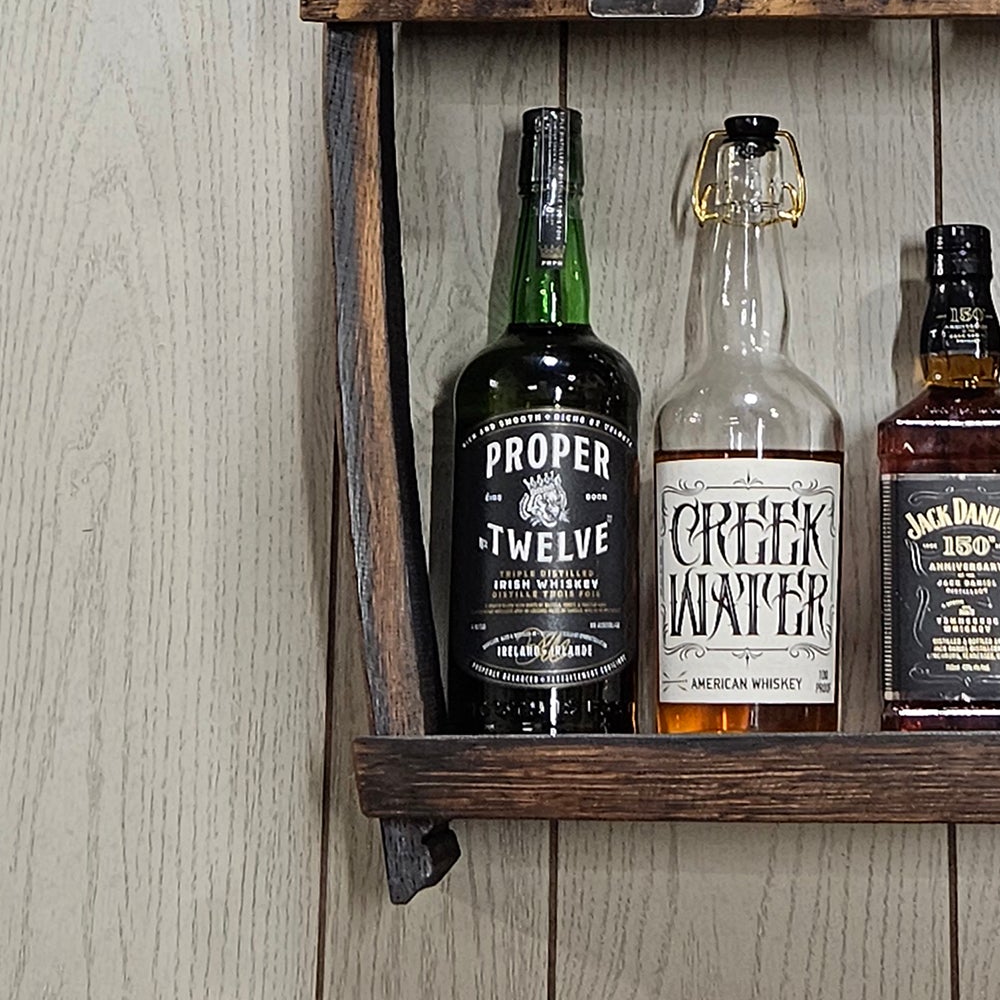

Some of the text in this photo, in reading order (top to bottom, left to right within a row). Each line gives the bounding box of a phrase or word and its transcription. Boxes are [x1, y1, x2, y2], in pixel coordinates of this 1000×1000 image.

[498, 413, 542, 428] SMOOTH
[486, 432, 610, 480] PROPER
[669, 495, 829, 569] CREEK
[904, 504, 953, 540] JACK
[487, 521, 609, 563] TWELVE
[493, 578, 599, 590] IRISH WHISKEY
[540, 569, 594, 578] DISTILLED
[669, 567, 829, 640] WATER
[691, 677, 803, 690] AMERICAN WHISKEY
